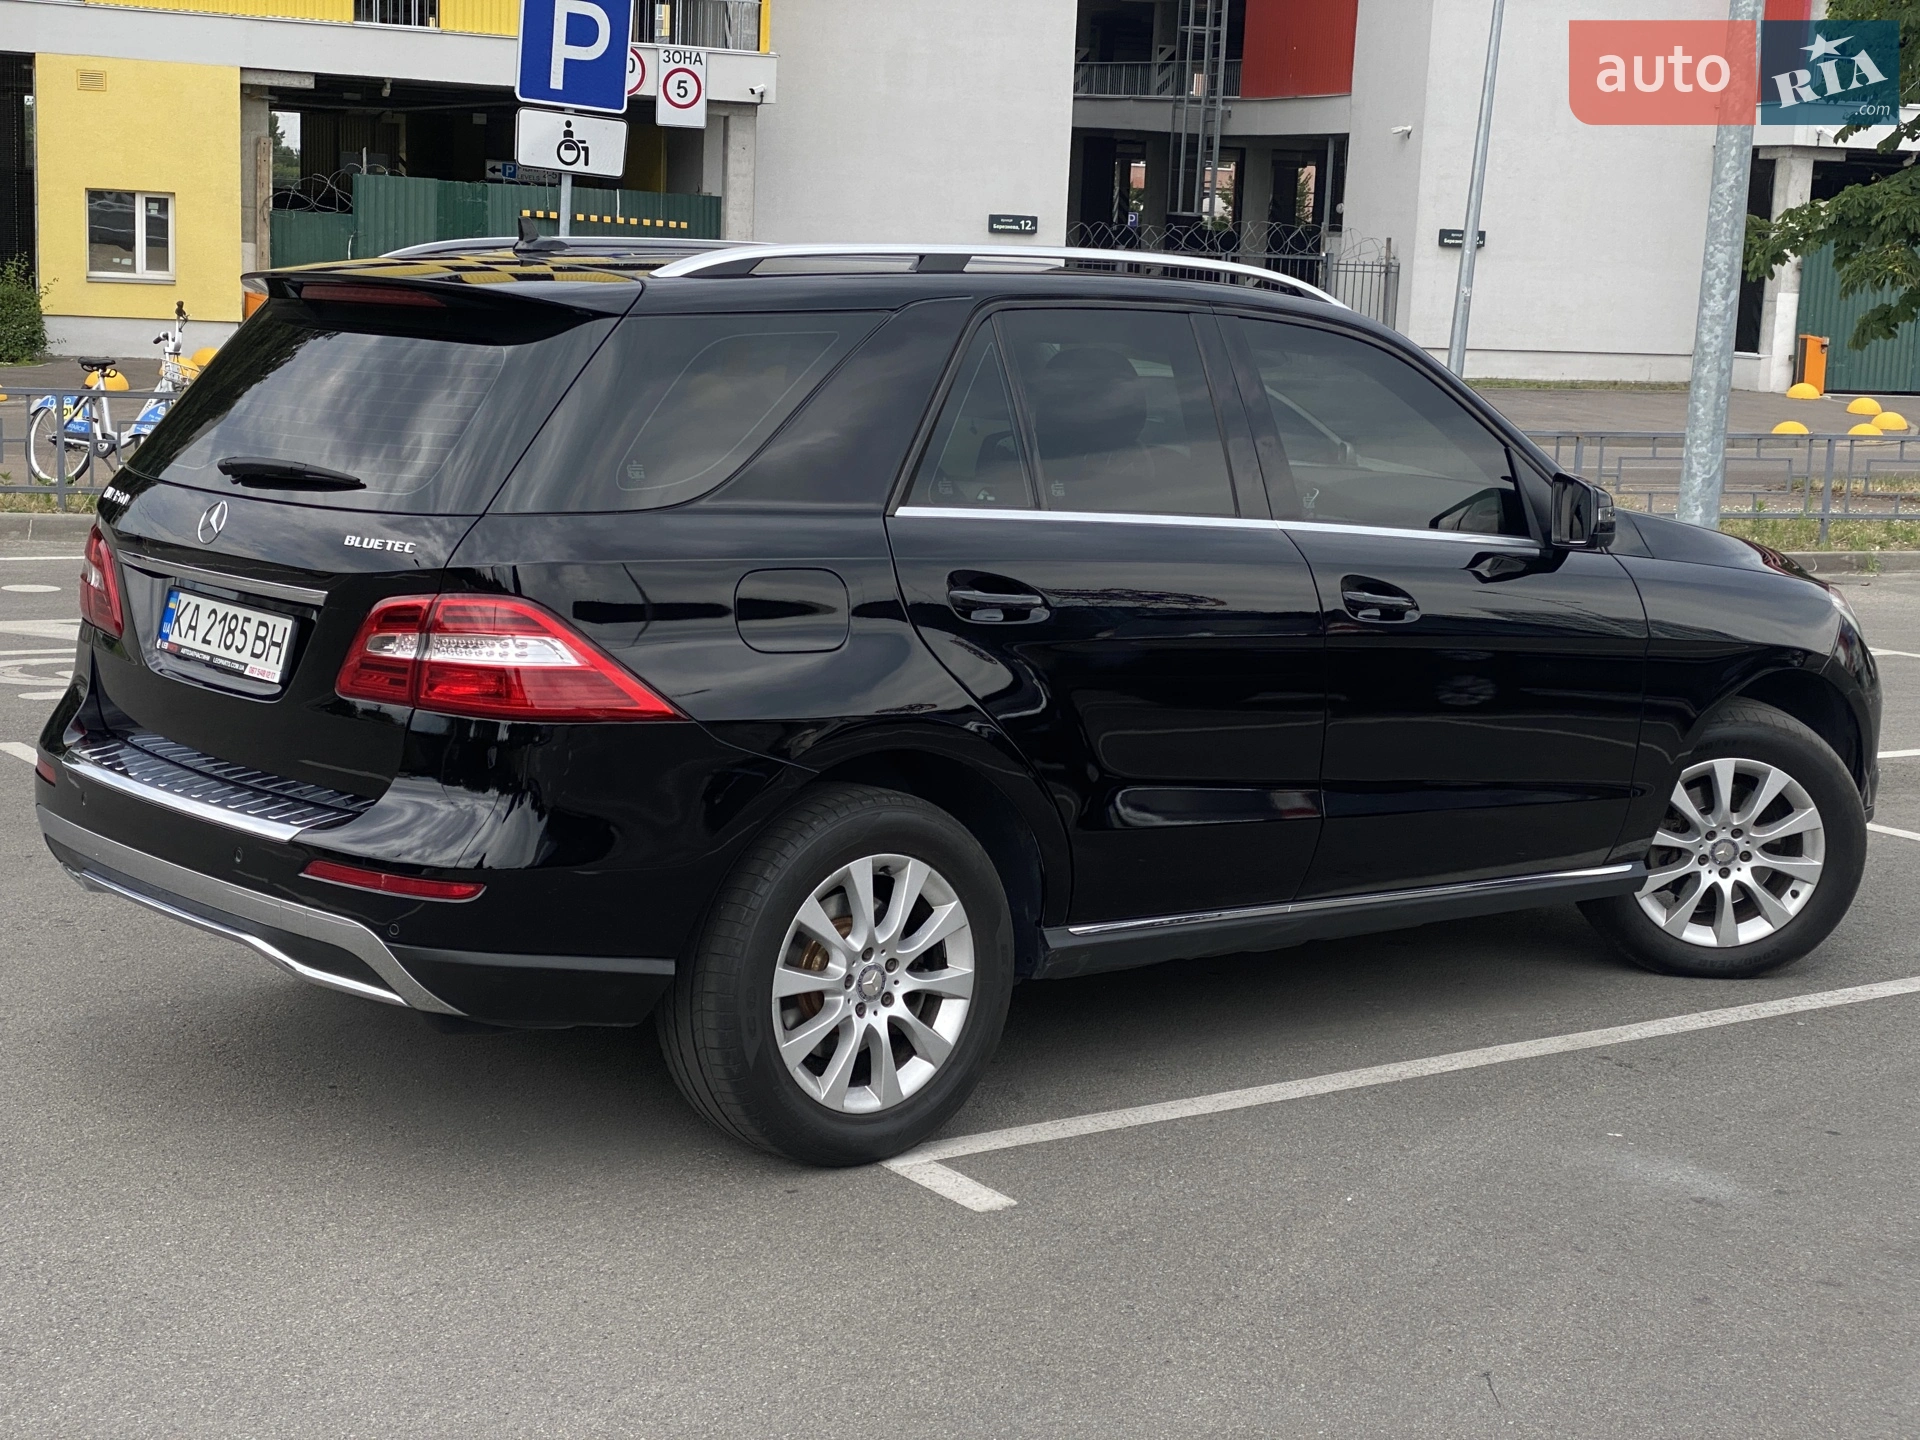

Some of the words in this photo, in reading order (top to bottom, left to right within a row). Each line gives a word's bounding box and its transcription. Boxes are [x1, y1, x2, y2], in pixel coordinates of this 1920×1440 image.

[550, 0, 611, 90] P
[662, 49, 704, 66] ЗОНА
[676, 80, 689, 98] 5
[343, 534, 417, 554] BLUETEC
[162, 622, 171, 634] UA
[171, 599, 200, 642] KA
[201, 607, 252, 654] 2185
[250, 620, 288, 665] BH
